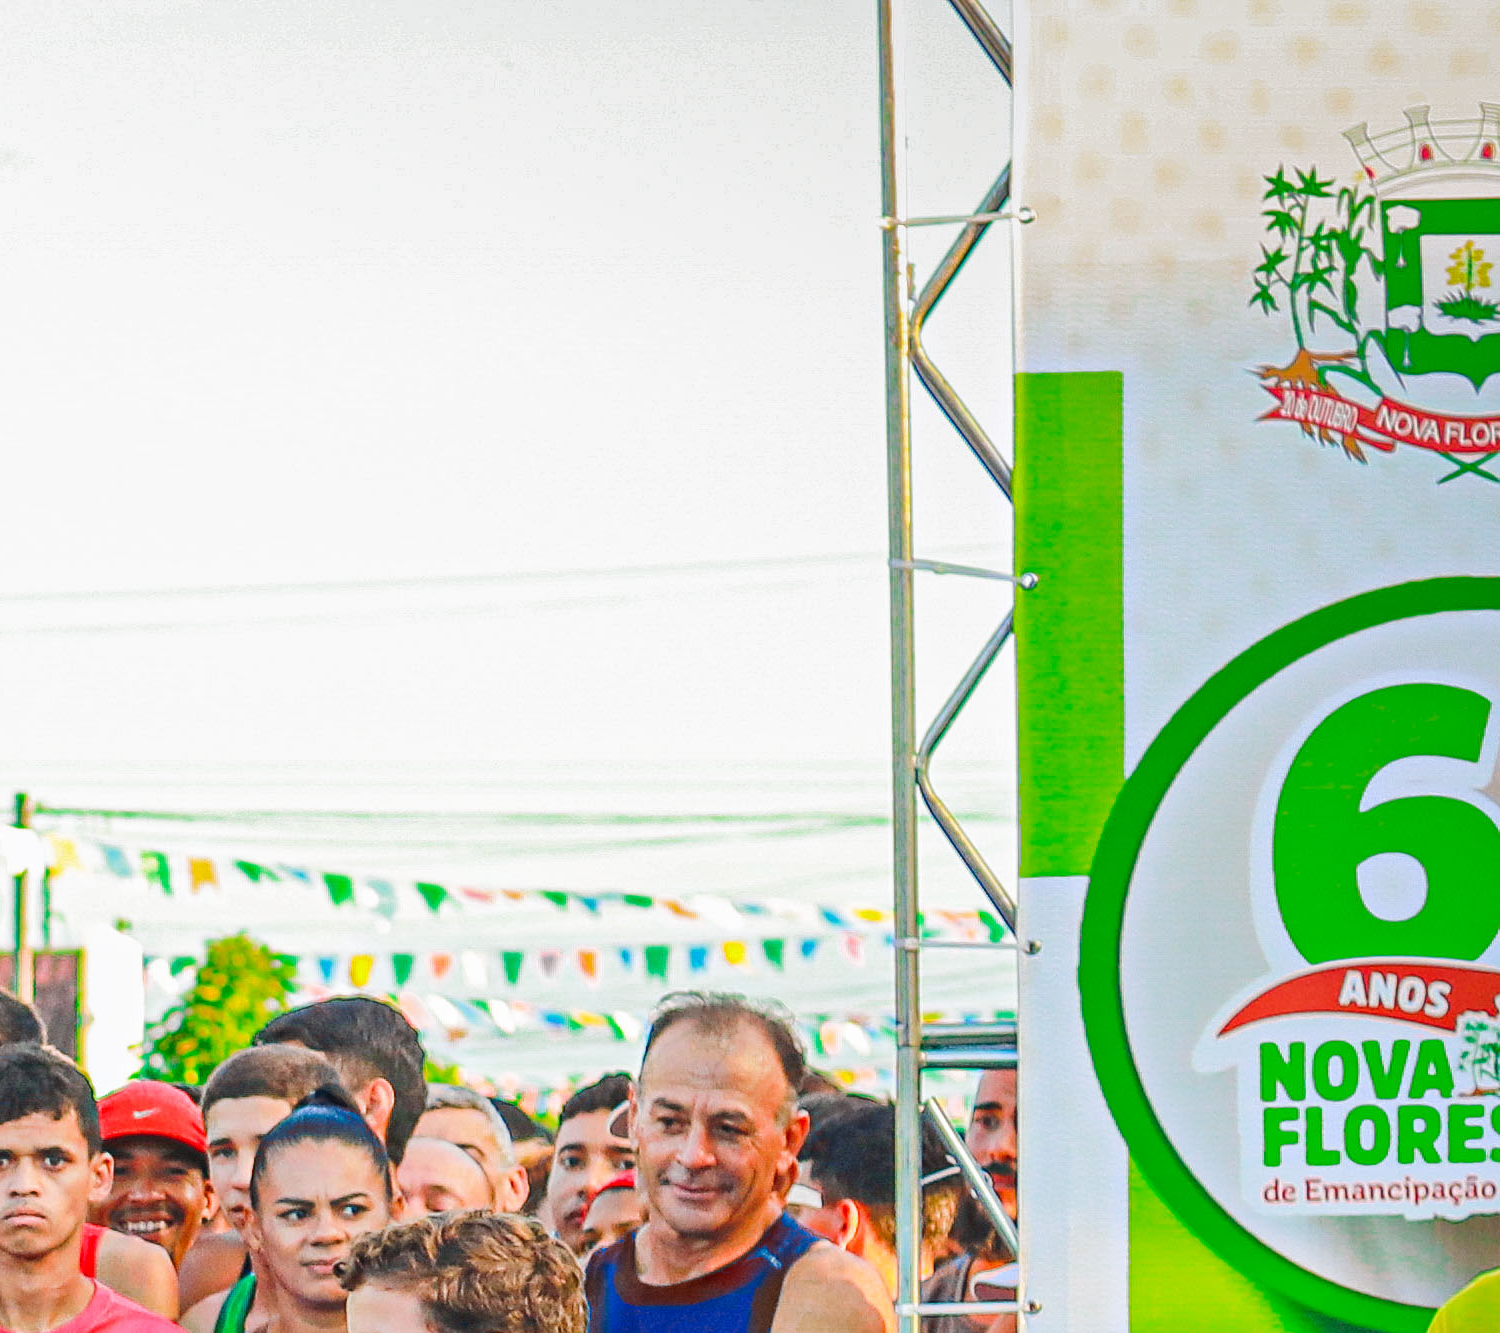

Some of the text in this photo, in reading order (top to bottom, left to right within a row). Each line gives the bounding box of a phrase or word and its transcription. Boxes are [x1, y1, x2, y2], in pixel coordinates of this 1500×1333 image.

[1376, 404, 1441, 444] NOVA
[1337, 969, 1453, 1019] ANOS
[1259, 1038, 1455, 1102] NOVA
[1263, 1103, 1500, 1168] FLORE
[1263, 1174, 1497, 1206] de Emancipação
